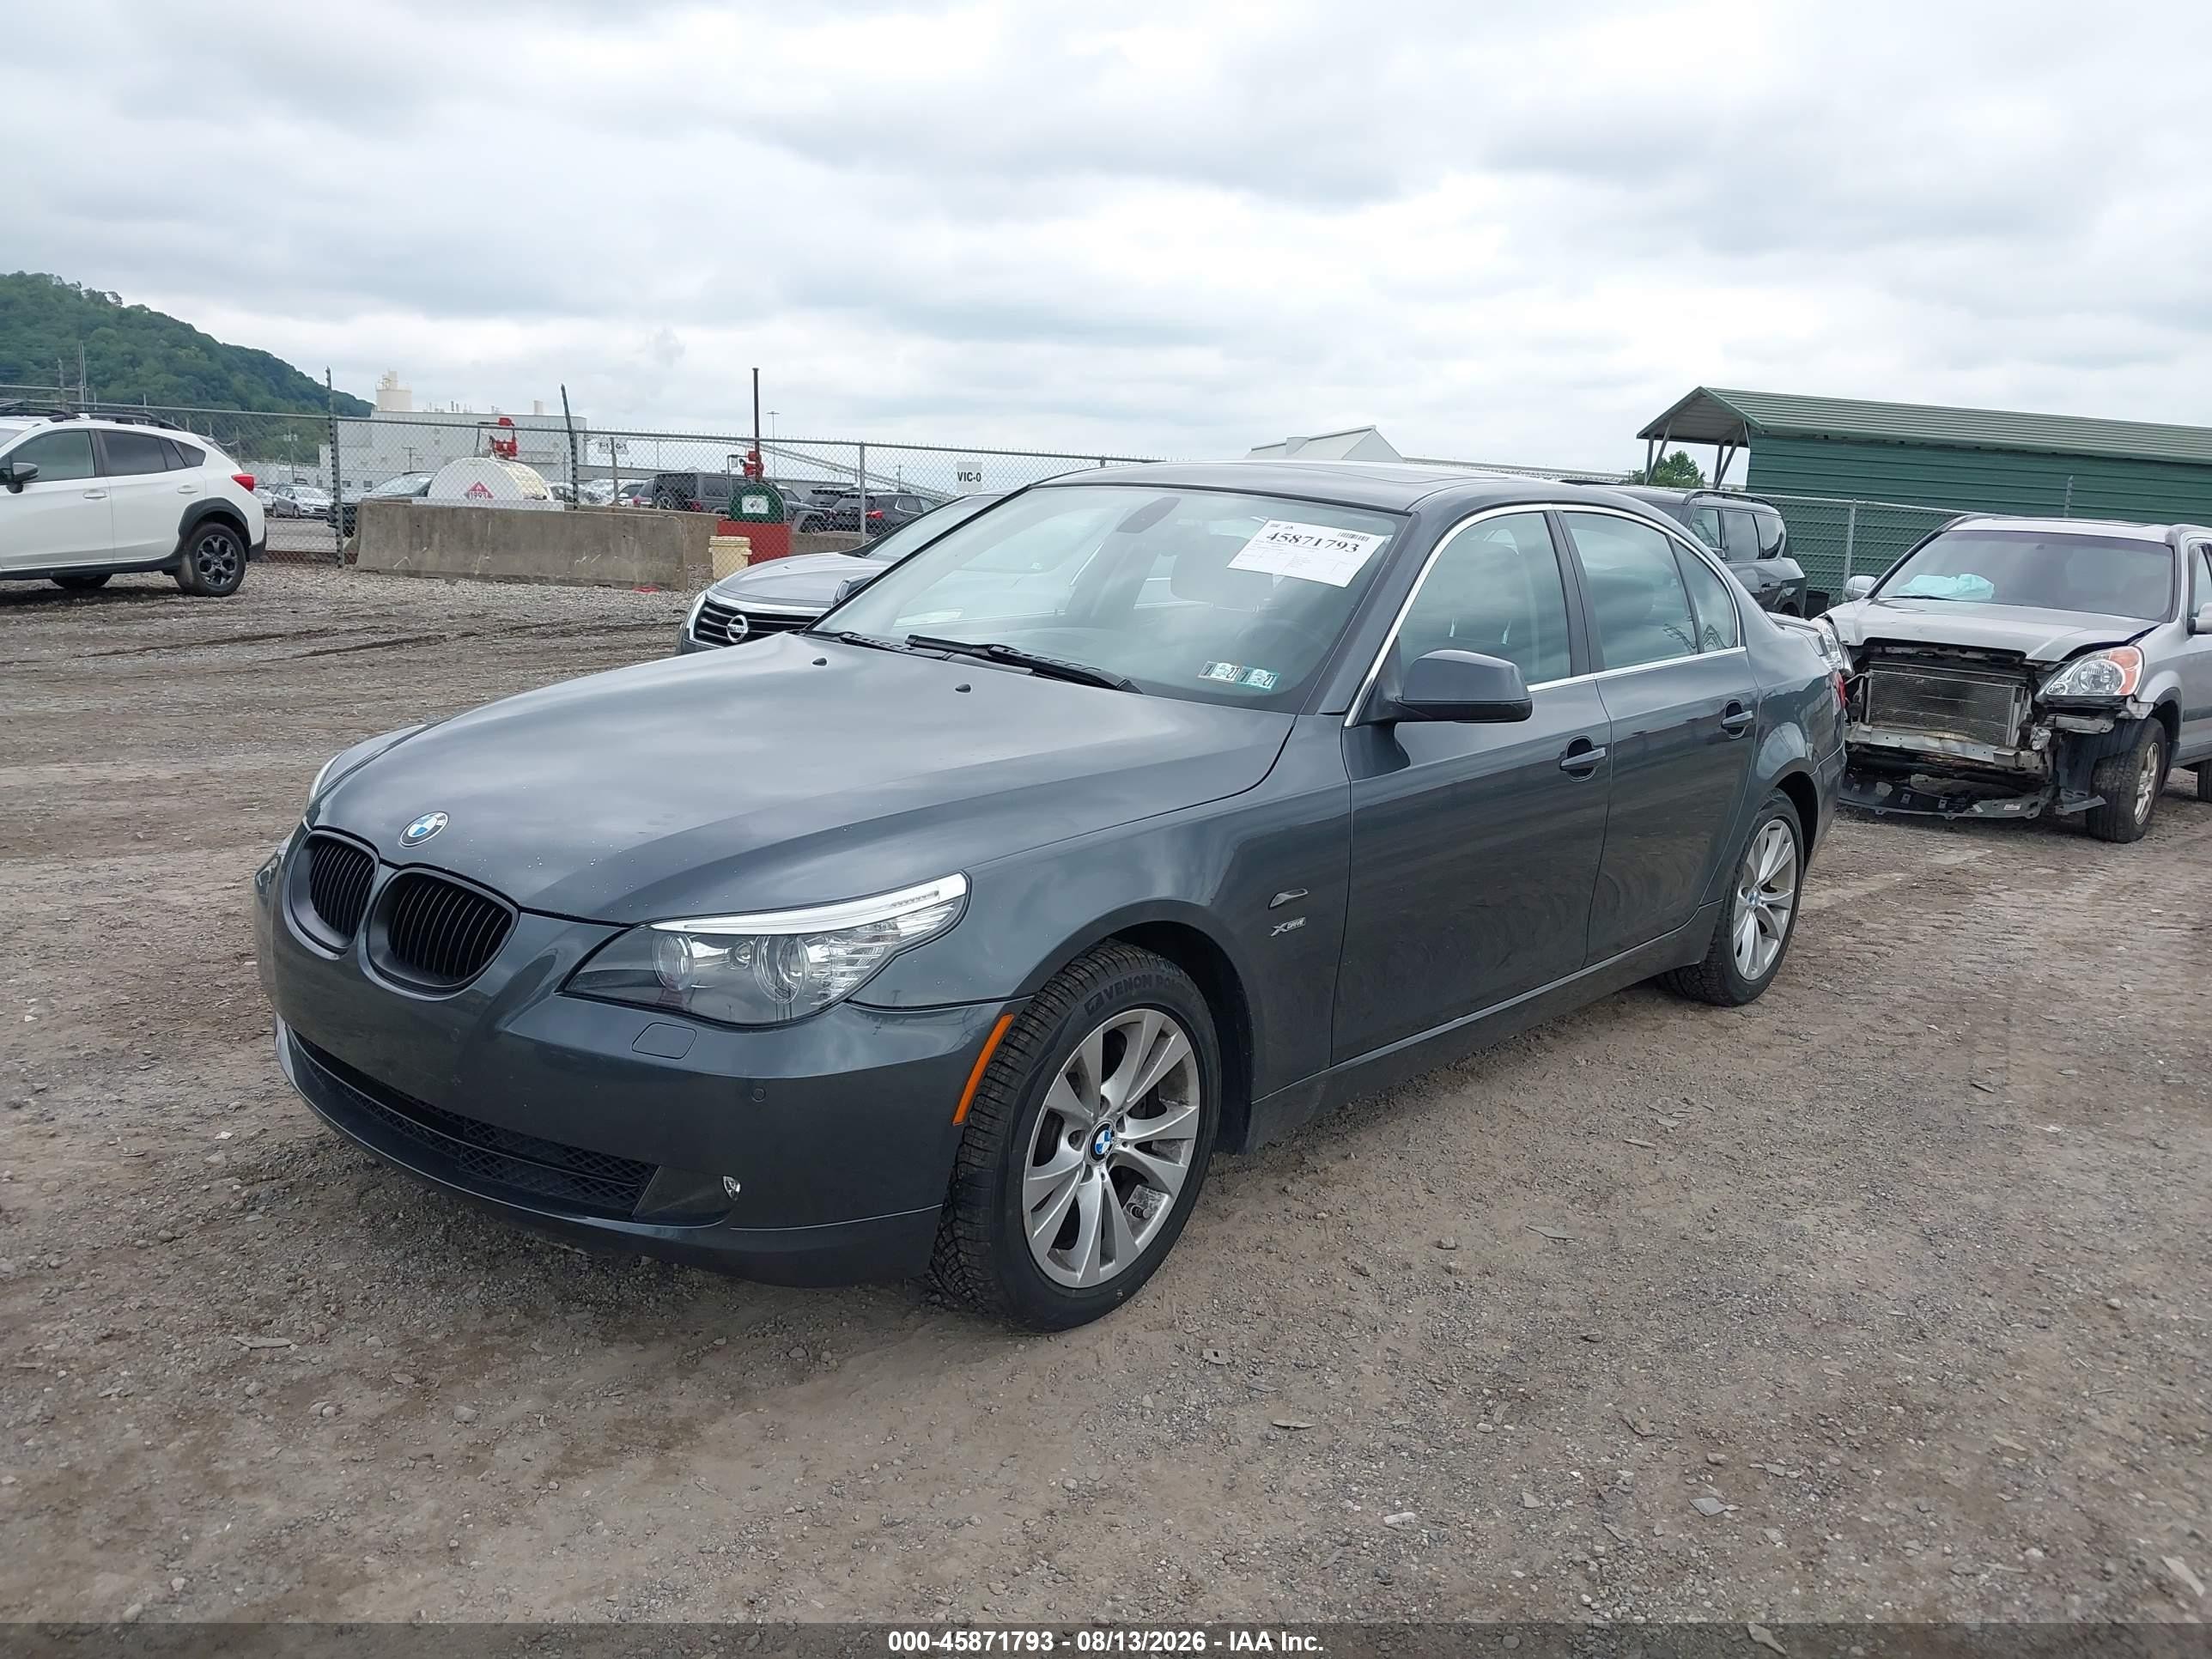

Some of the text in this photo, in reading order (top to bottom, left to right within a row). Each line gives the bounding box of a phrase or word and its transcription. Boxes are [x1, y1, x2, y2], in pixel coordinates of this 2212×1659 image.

[1266, 532, 1360, 553] 45871793
[1226, 666, 1240, 681] 27
[1263, 673, 1276, 688] 27
